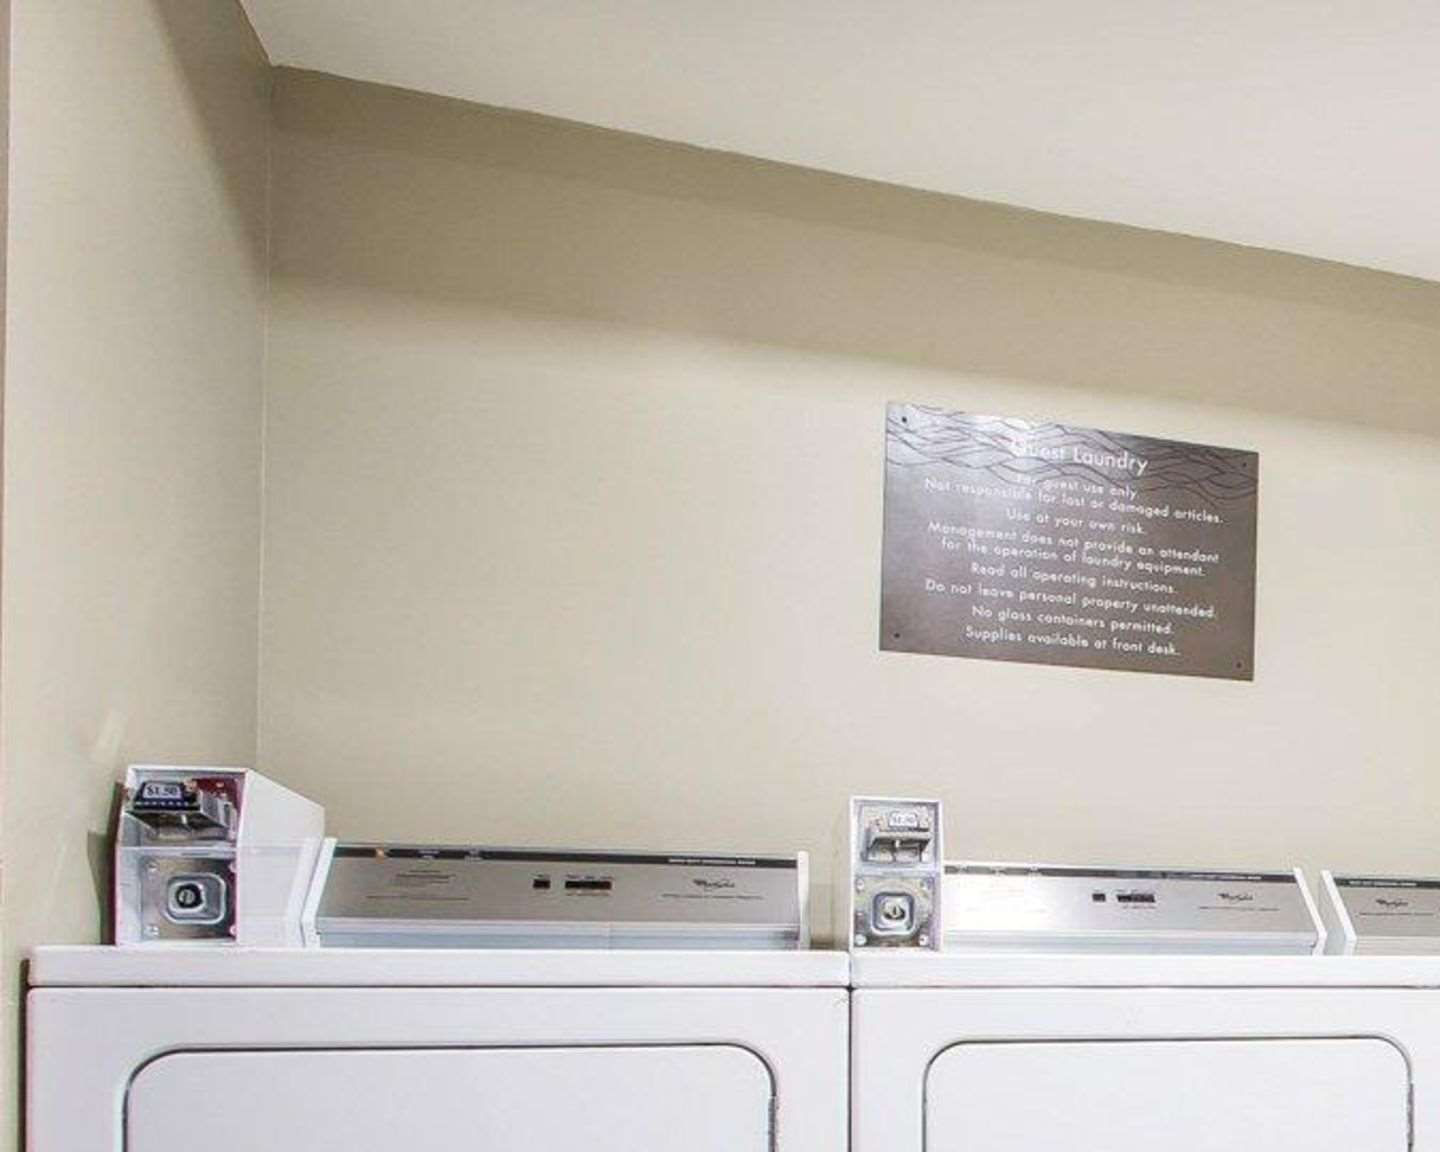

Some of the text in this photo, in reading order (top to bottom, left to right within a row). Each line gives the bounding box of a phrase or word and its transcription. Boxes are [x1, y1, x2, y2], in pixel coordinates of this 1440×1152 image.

[1074, 446, 1148, 477] Laundry
[925, 477, 950, 493] Not
[1038, 488, 1056, 503] for
[1061, 492, 1085, 506] lost
[1090, 499, 1104, 509] or
[1109, 500, 1170, 519] damaged
[1174, 509, 1224, 524] articles.
[1083, 483, 1104, 494] use
[1006, 507, 1031, 520] Use
[1036, 513, 1049, 524] at
[1055, 516, 1083, 529] your
[1088, 519, 1116, 532] own
[928, 521, 1219, 563] Management does not provide an attendant
[941, 536, 1206, 577] for the operation of laundry equipment.
[971, 561, 1177, 593] Read all operating instructions.
[925, 578, 1217, 618] Do not leave personal property unattended.
[972, 605, 1175, 634] No glass containers permitted.
[965, 625, 1181, 656] Supplies available at front desk.
